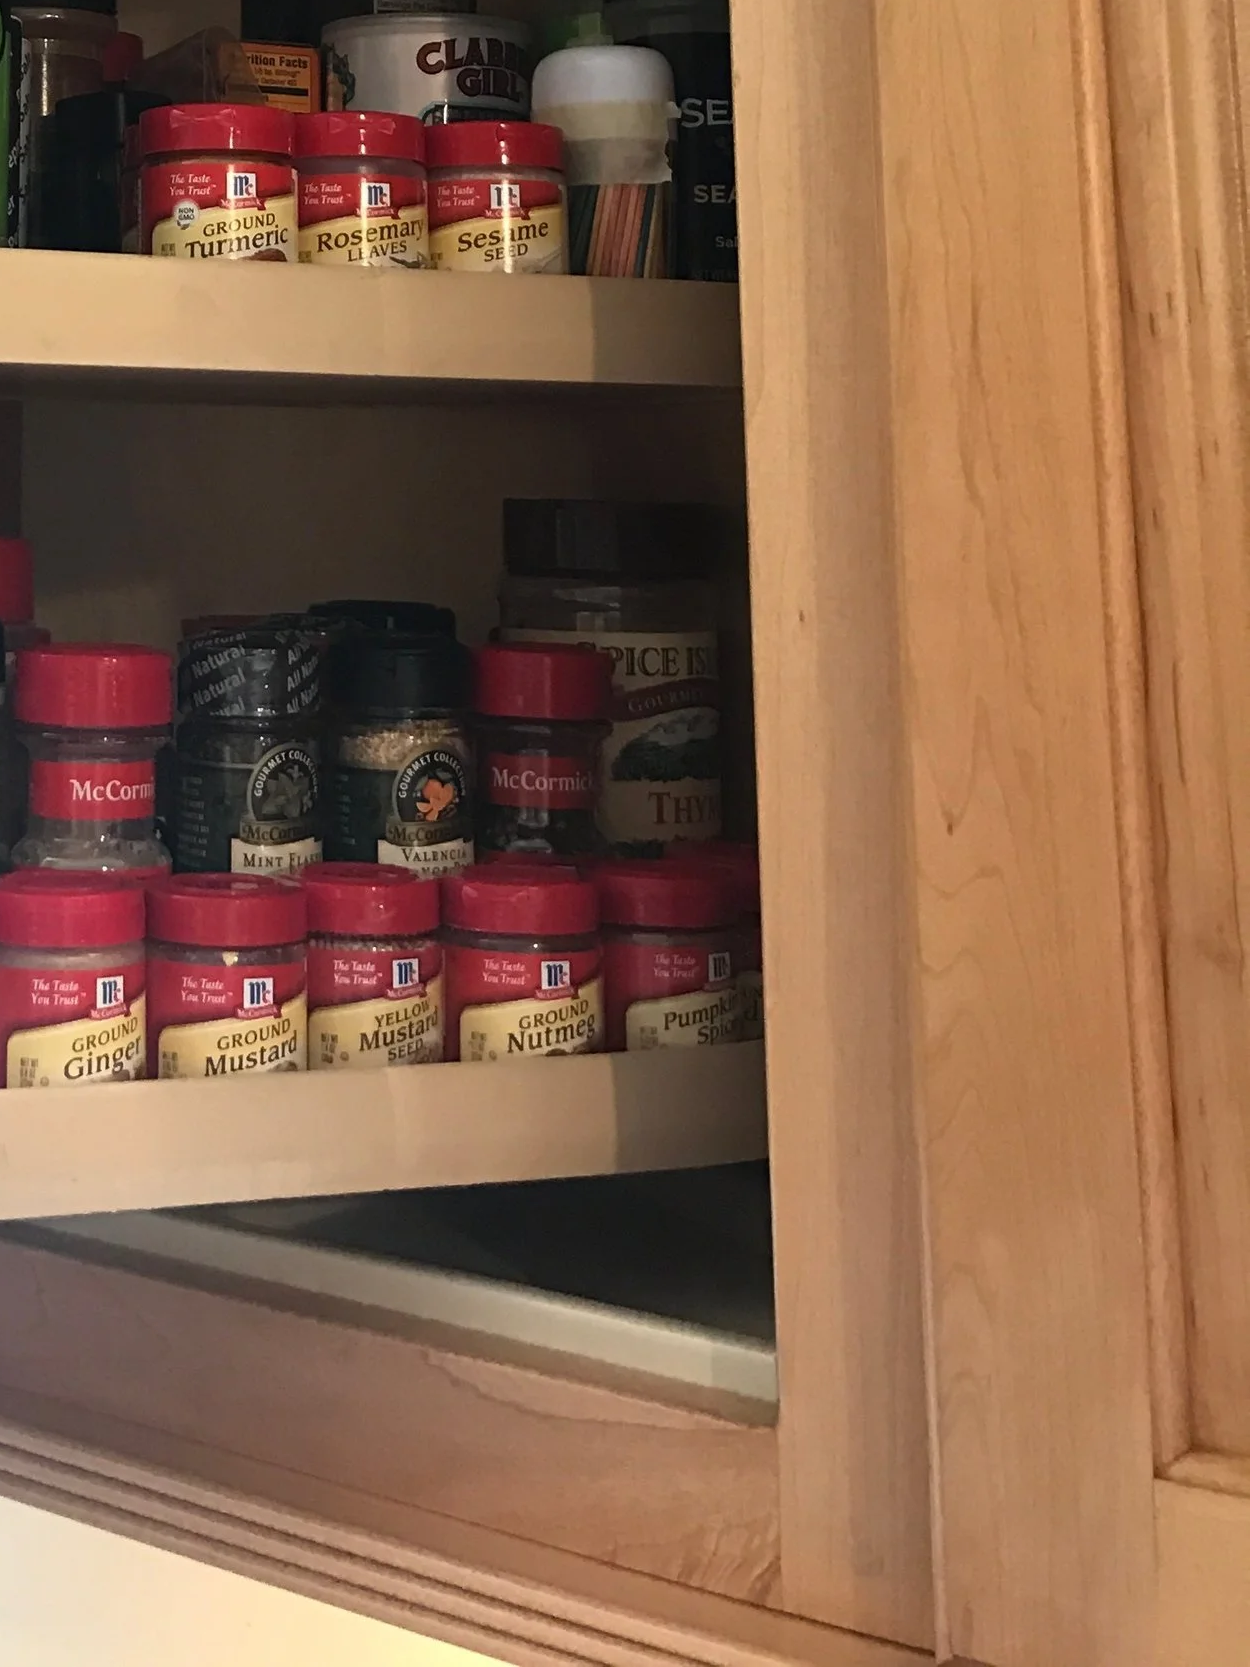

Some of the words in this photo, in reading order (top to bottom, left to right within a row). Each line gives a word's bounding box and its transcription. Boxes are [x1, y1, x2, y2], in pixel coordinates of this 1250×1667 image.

[246, 53, 276, 67] rition
[279, 56, 308, 69] Facts
[456, 67, 521, 103] GIRL
[169, 173, 185, 184] The
[187, 173, 211, 184] Taste
[304, 183, 319, 194] The
[320, 183, 342, 193] Taste
[169, 186, 185, 196] You
[303, 196, 319, 206] You
[437, 185, 450, 196] The
[452, 185, 475, 195] Taste
[178, 207, 195, 215] NON
[436, 198, 451, 207] You
[178, 213, 195, 222] GMO
[203, 213, 276, 238] GROUND
[184, 224, 288, 259] Turmeric
[316, 218, 424, 253] Rosemary
[457, 221, 549, 253] Sesame
[484, 242, 528, 263] SEED
[190, 644, 247, 679] Natural
[192, 666, 247, 708] Natural
[287, 669, 301, 693] All
[253, 751, 288, 797] GOURMET
[398, 755, 431, 798] GOURMET
[69, 775, 155, 801] McCorm
[242, 852, 284, 868] MINT
[401, 847, 468, 863] VALENCIA
[333, 958, 349, 971] The
[351, 959, 376, 972] Taste
[483, 958, 500, 971] The
[501, 959, 526, 972] Taste
[32, 978, 50, 991] The
[53, 979, 79, 992] Taste
[181, 976, 198, 989] The
[201, 977, 224, 990] Taste
[333, 973, 350, 984] You
[482, 972, 498, 984] You
[31, 992, 50, 1006] You
[180, 990, 198, 1003] You
[374, 1000, 430, 1028] YELLOW
[518, 999, 589, 1030] GROUND
[71, 1016, 138, 1054] GROUND
[216, 1018, 291, 1051] GROUND
[358, 1005, 439, 1052] Mustard
[506, 1012, 595, 1054] Nutmeg
[63, 1035, 141, 1080] Ginger
[204, 1029, 298, 1077] Mustard
[387, 1037, 424, 1062] SEED
